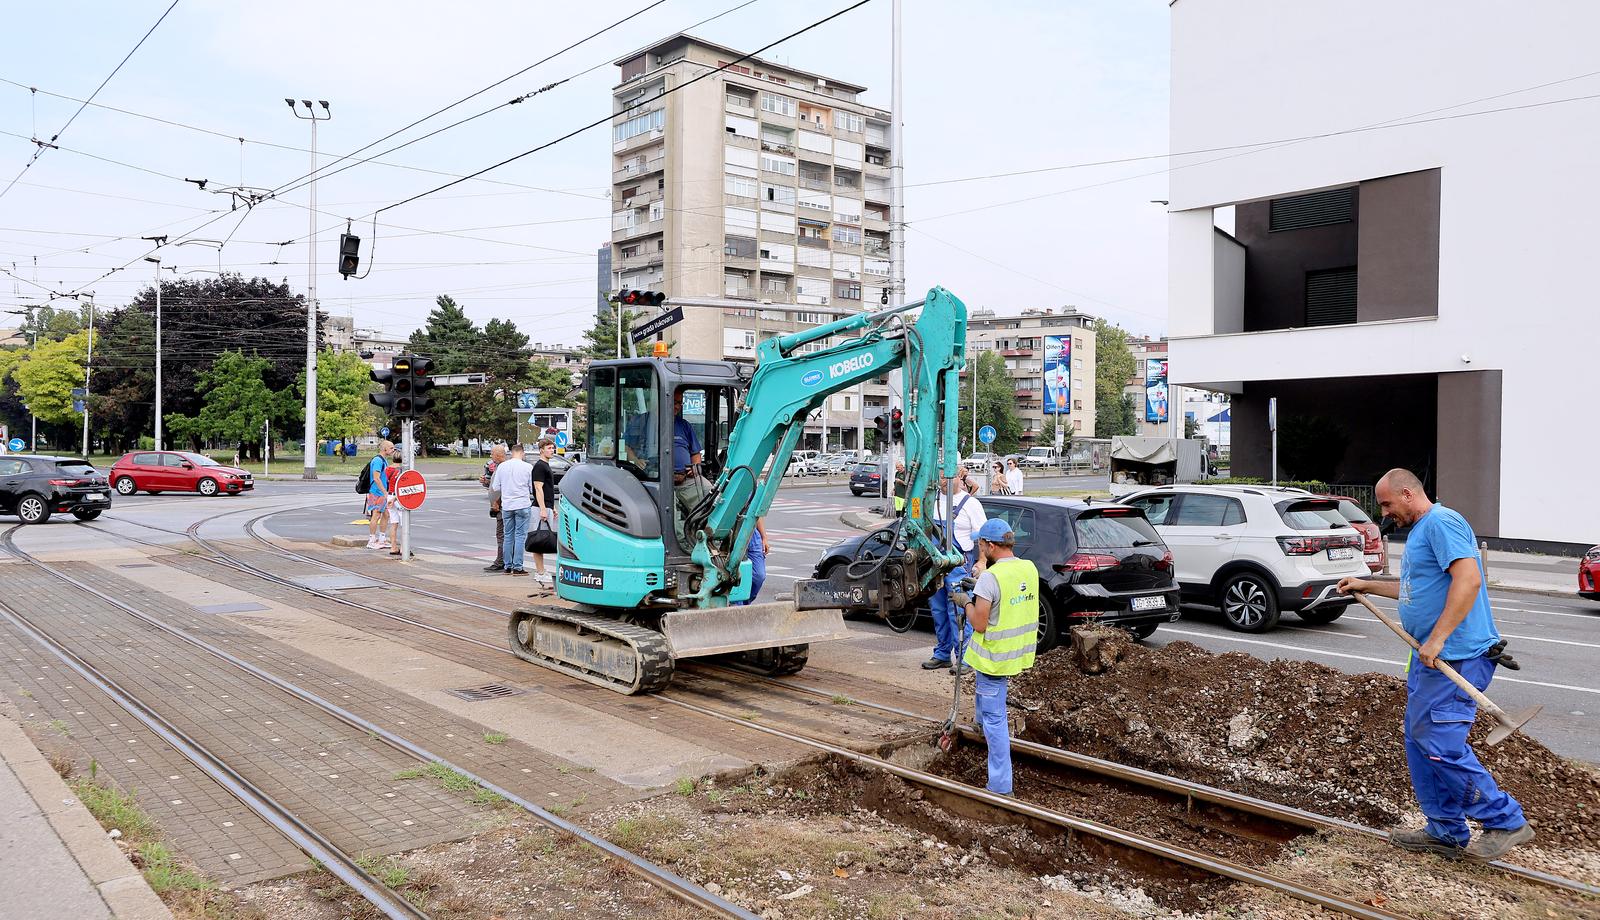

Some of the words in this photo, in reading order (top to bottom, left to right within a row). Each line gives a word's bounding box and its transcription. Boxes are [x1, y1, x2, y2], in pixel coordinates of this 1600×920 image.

[643, 324, 655, 337] grada
[828, 352, 874, 379] KOBELCO
[564, 569, 602, 586] OLMinfra
[1009, 592, 1036, 606] OLMinfr
